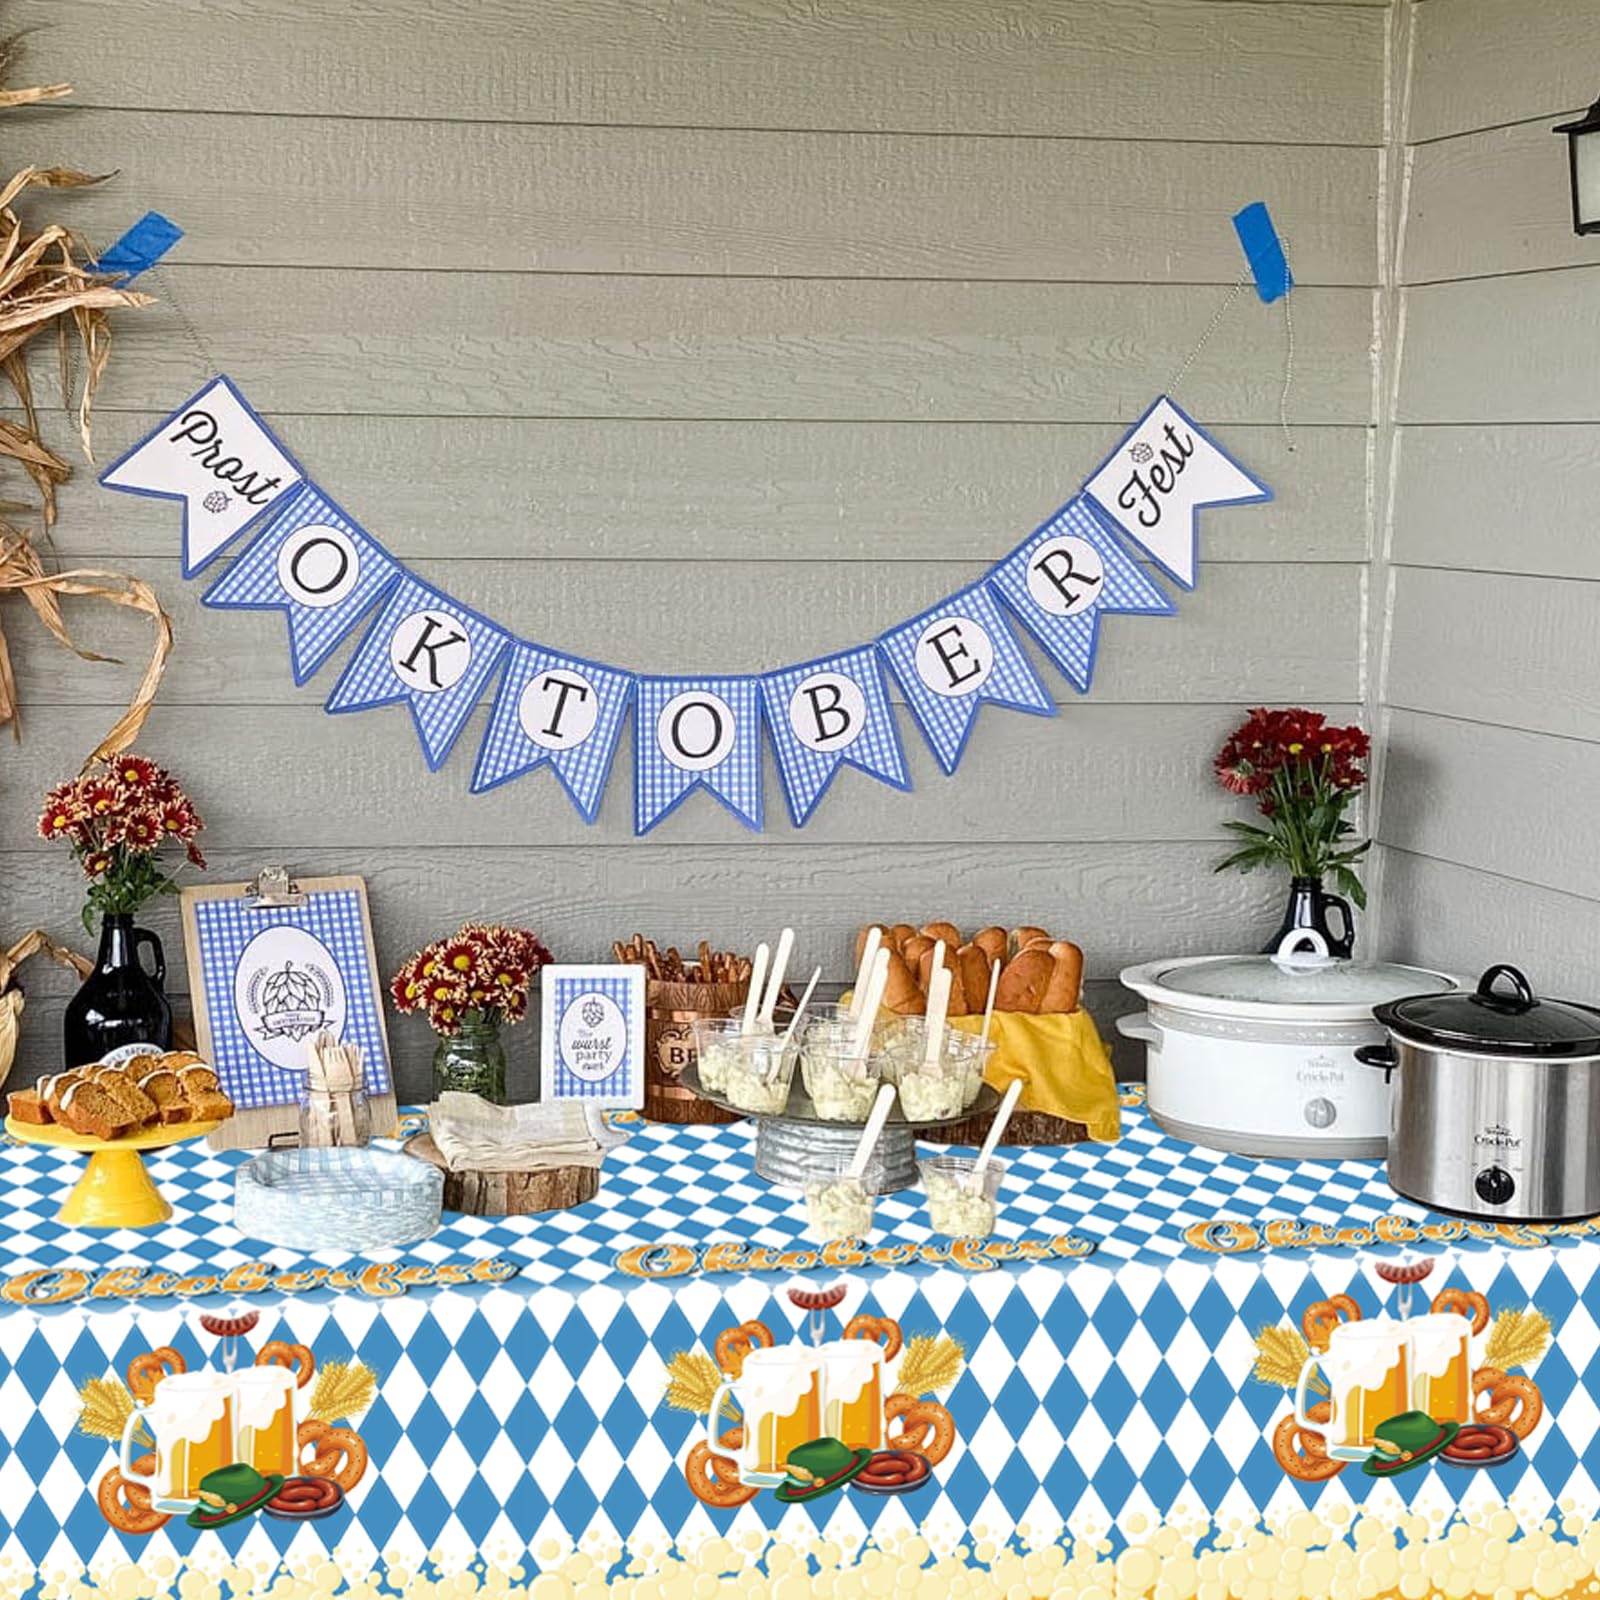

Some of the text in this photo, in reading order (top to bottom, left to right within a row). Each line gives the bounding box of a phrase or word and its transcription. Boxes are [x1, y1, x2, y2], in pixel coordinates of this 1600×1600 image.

[169, 410, 281, 505] Prost
[1118, 424, 1194, 527] Fest
[571, 1036, 613, 1050] wurst
[575, 1050, 612, 1064] party
[614, 1236, 1097, 1276] Oktoberfest
[2, 1259, 519, 1304] Oktoberfest
